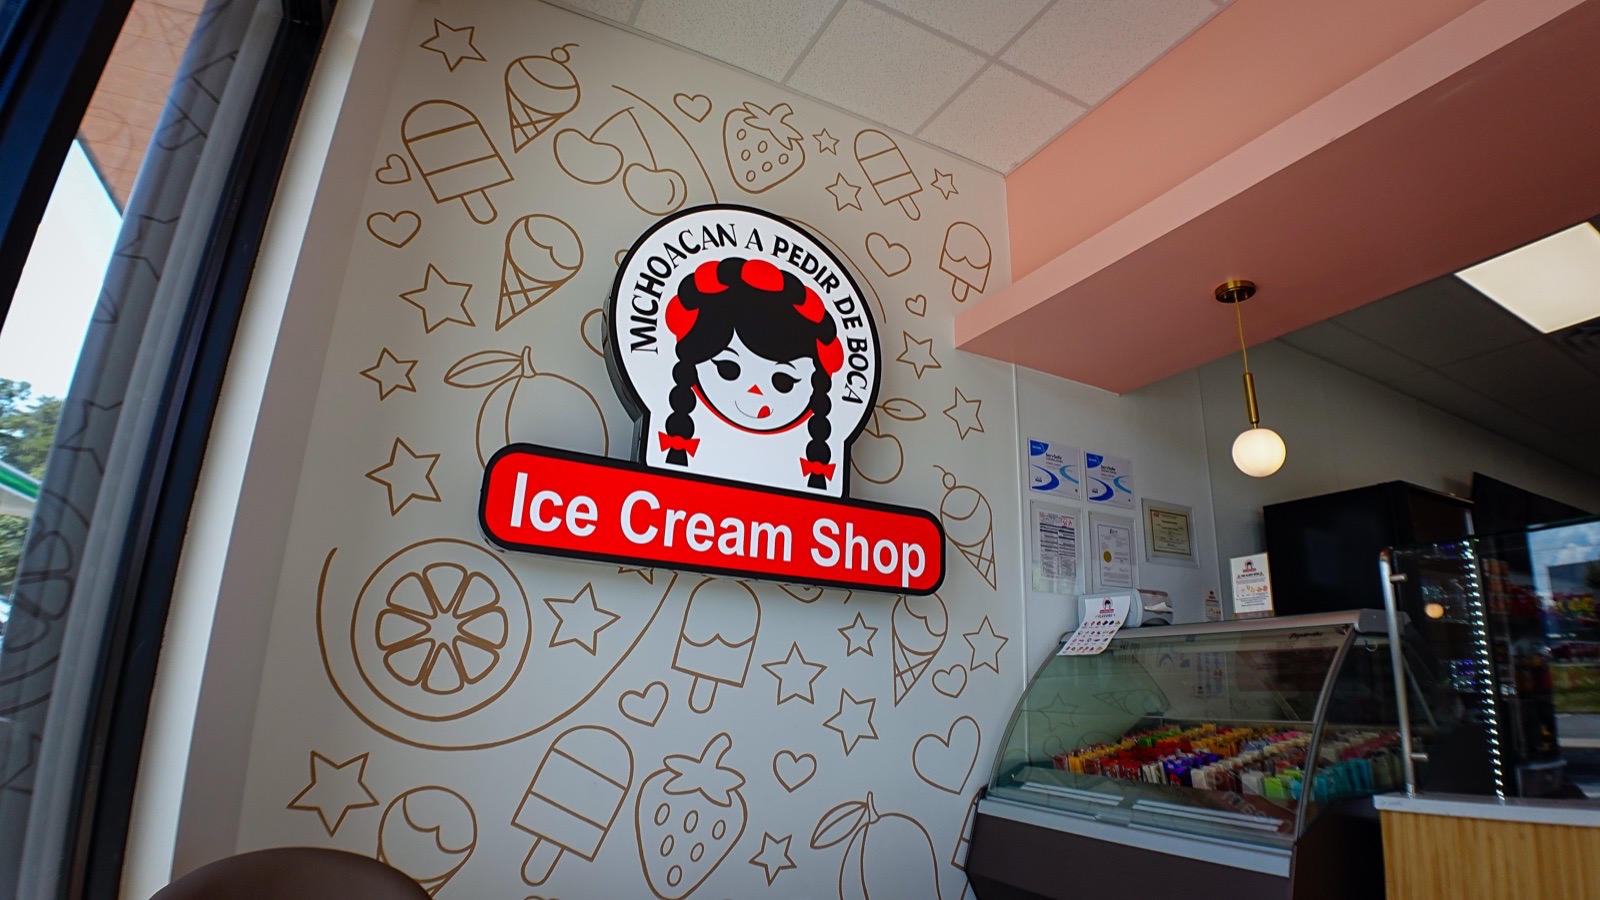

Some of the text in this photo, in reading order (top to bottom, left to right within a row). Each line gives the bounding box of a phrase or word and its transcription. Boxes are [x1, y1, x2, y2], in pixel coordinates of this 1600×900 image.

[630, 223, 870, 405] MICHOACAN A PEDIR DE BOCA
[510, 472, 926, 588] Ice Cream Shop
